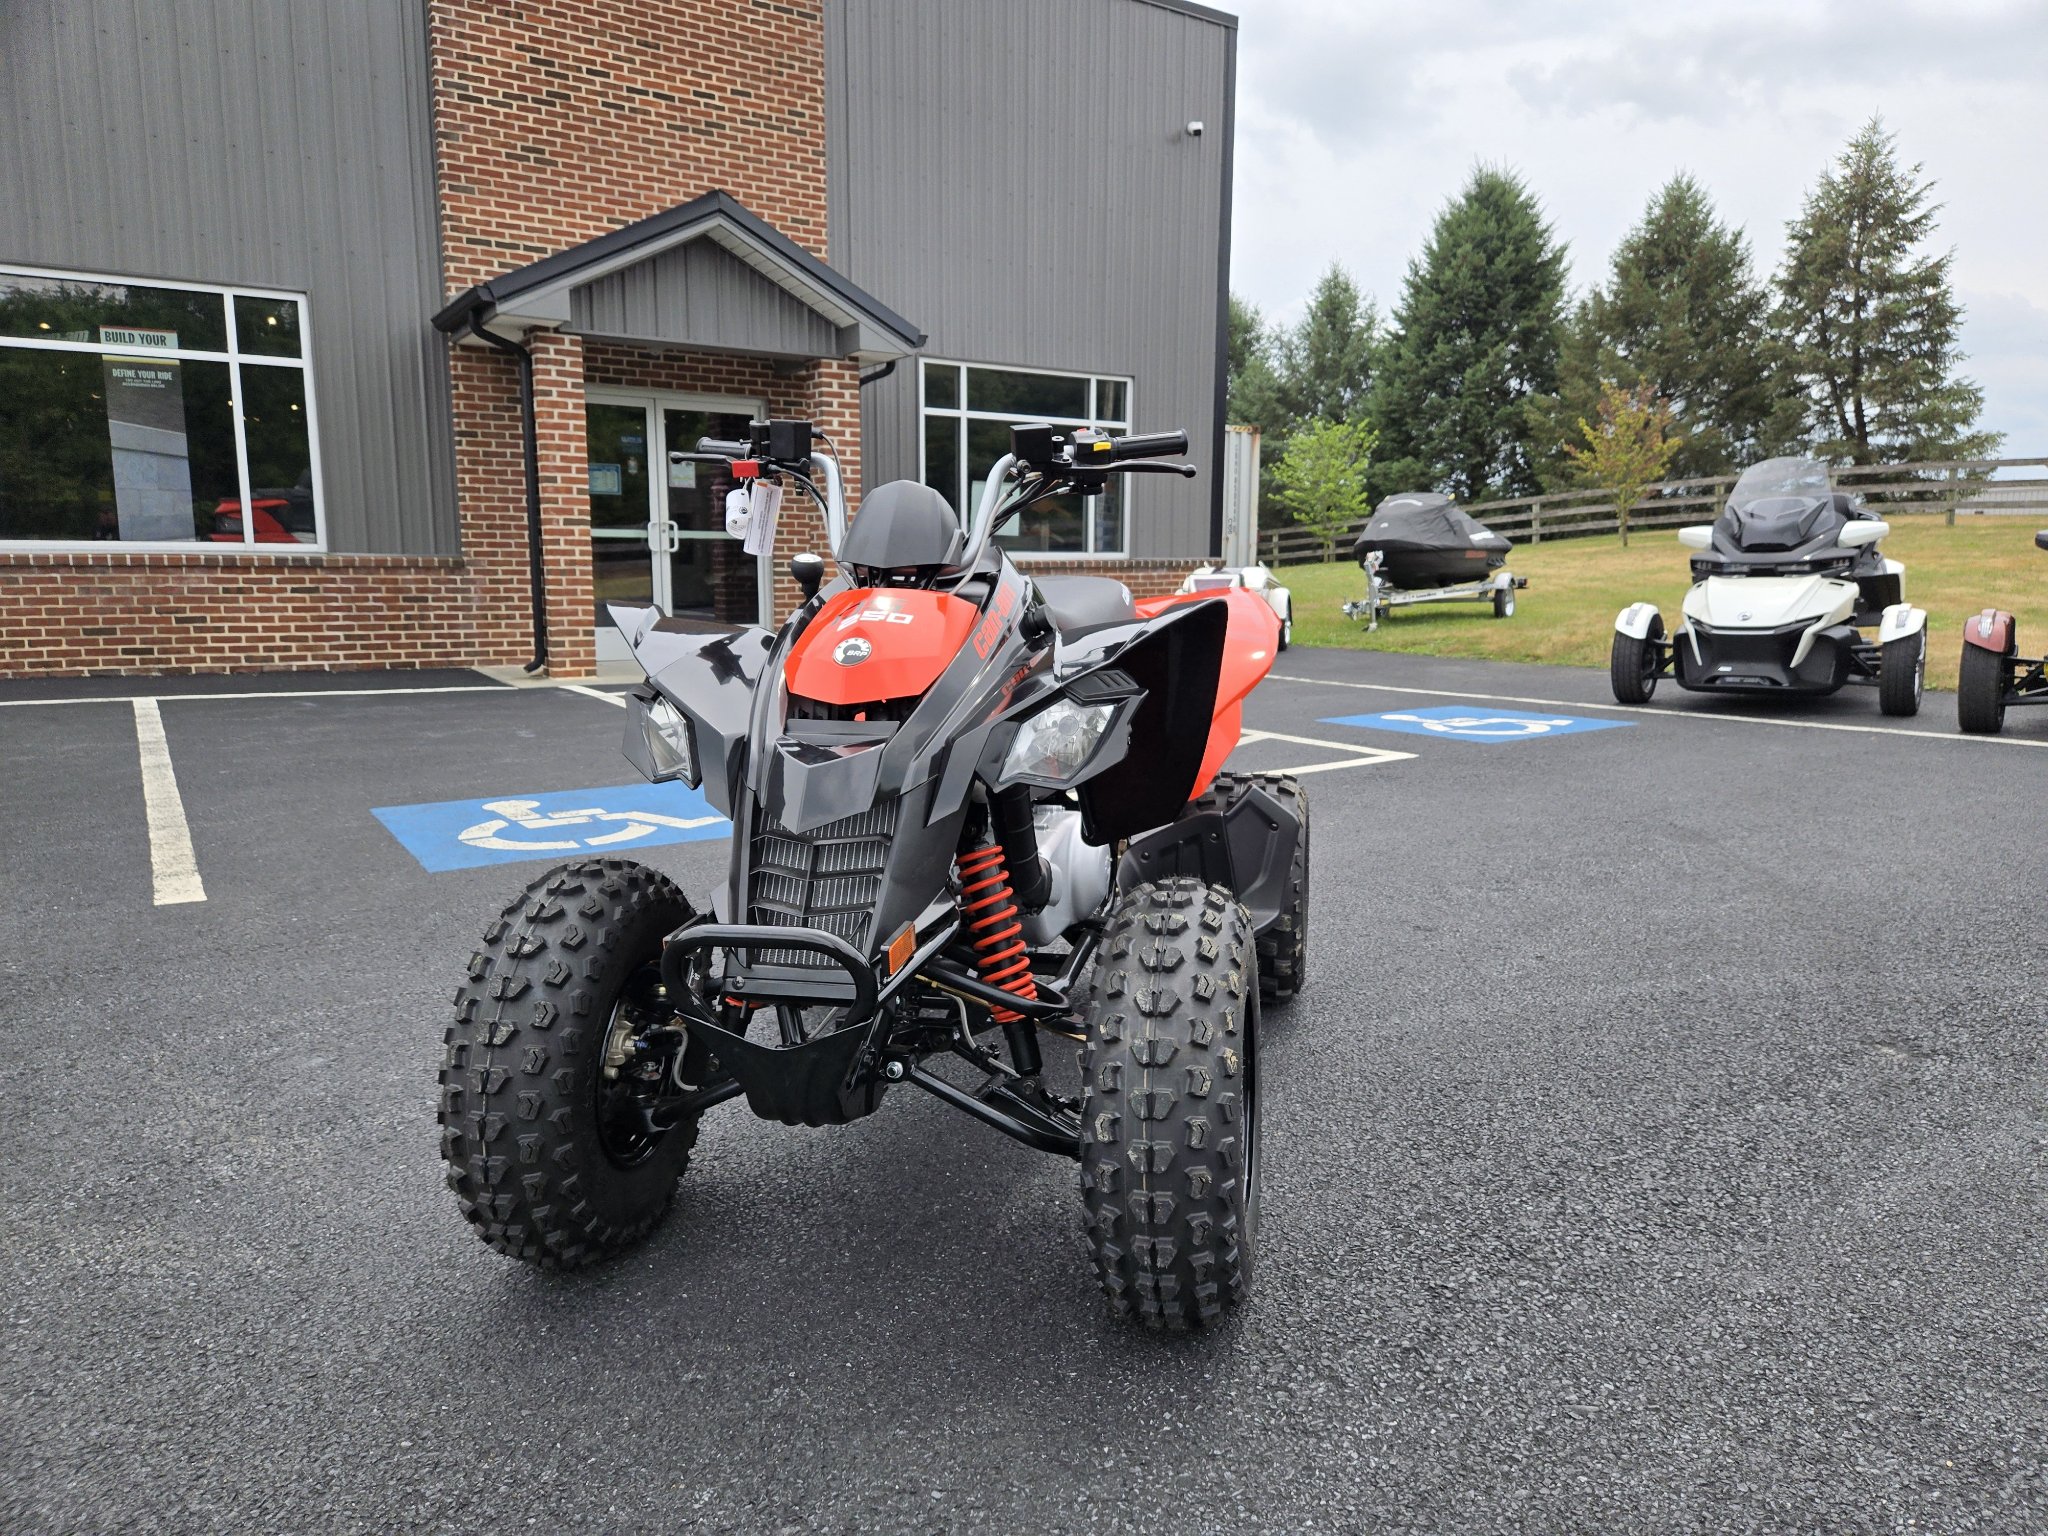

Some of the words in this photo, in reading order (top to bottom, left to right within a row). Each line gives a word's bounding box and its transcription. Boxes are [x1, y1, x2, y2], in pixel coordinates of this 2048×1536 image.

[104, 331, 135, 344] BUILD
[138, 333, 167, 346] YOUR
[112, 368, 136, 378] DEFINE
[138, 370, 156, 379] YOUR
[157, 371, 173, 380] RIDE
[836, 610, 914, 632] 250
[846, 648, 868, 657] BRP
